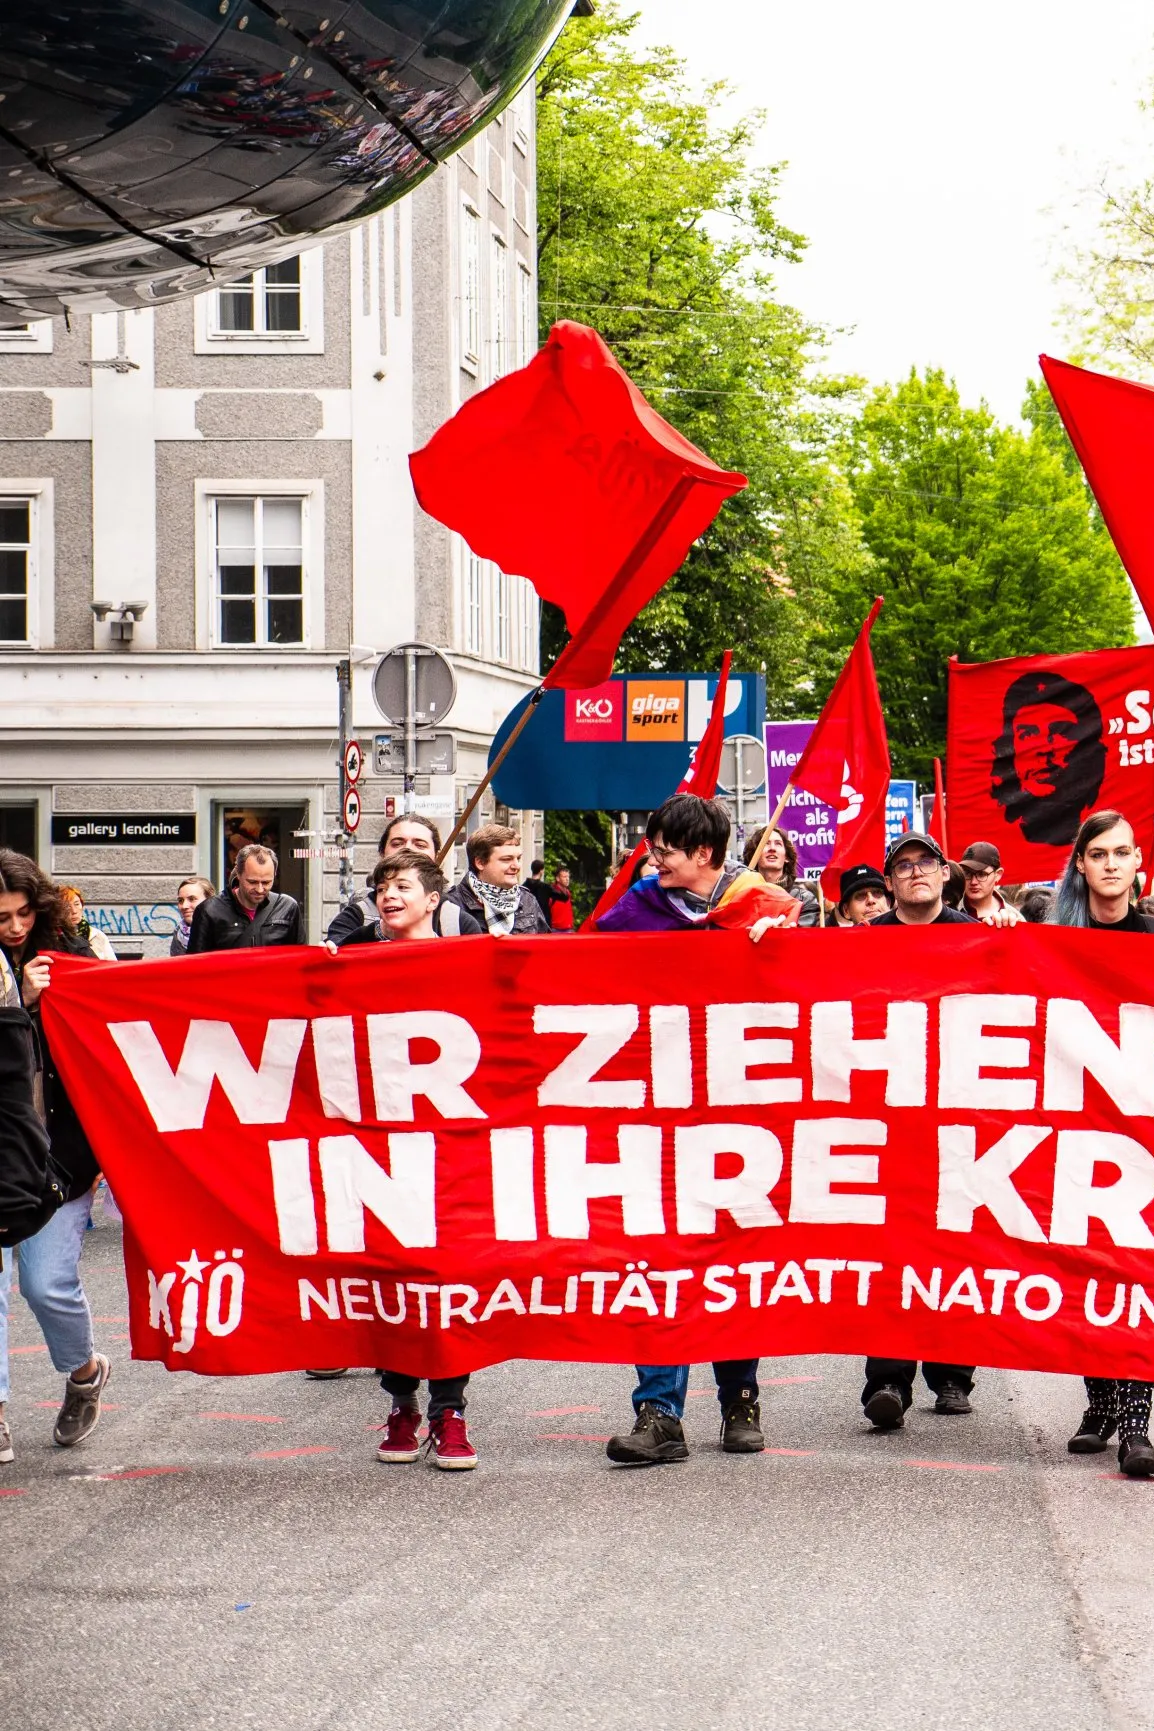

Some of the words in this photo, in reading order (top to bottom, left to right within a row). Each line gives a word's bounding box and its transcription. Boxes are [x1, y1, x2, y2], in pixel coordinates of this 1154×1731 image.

[631, 693, 680, 715] giga
[632, 712, 678, 726] sport
[1119, 739, 1154, 767] ist
[805, 807, 829, 826] als
[69, 823, 117, 837] gallery
[122, 823, 180, 835] lendnine
[787, 827, 835, 847] Profit
[107, 1011, 488, 1132] WIR
[268, 1132, 436, 1255] IN
[490, 1118, 887, 1241] IHRE
[299, 1261, 693, 1329] NEUTRALITÄT
[703, 1259, 883, 1314] STATT
[902, 1265, 1063, 1321] NATO
